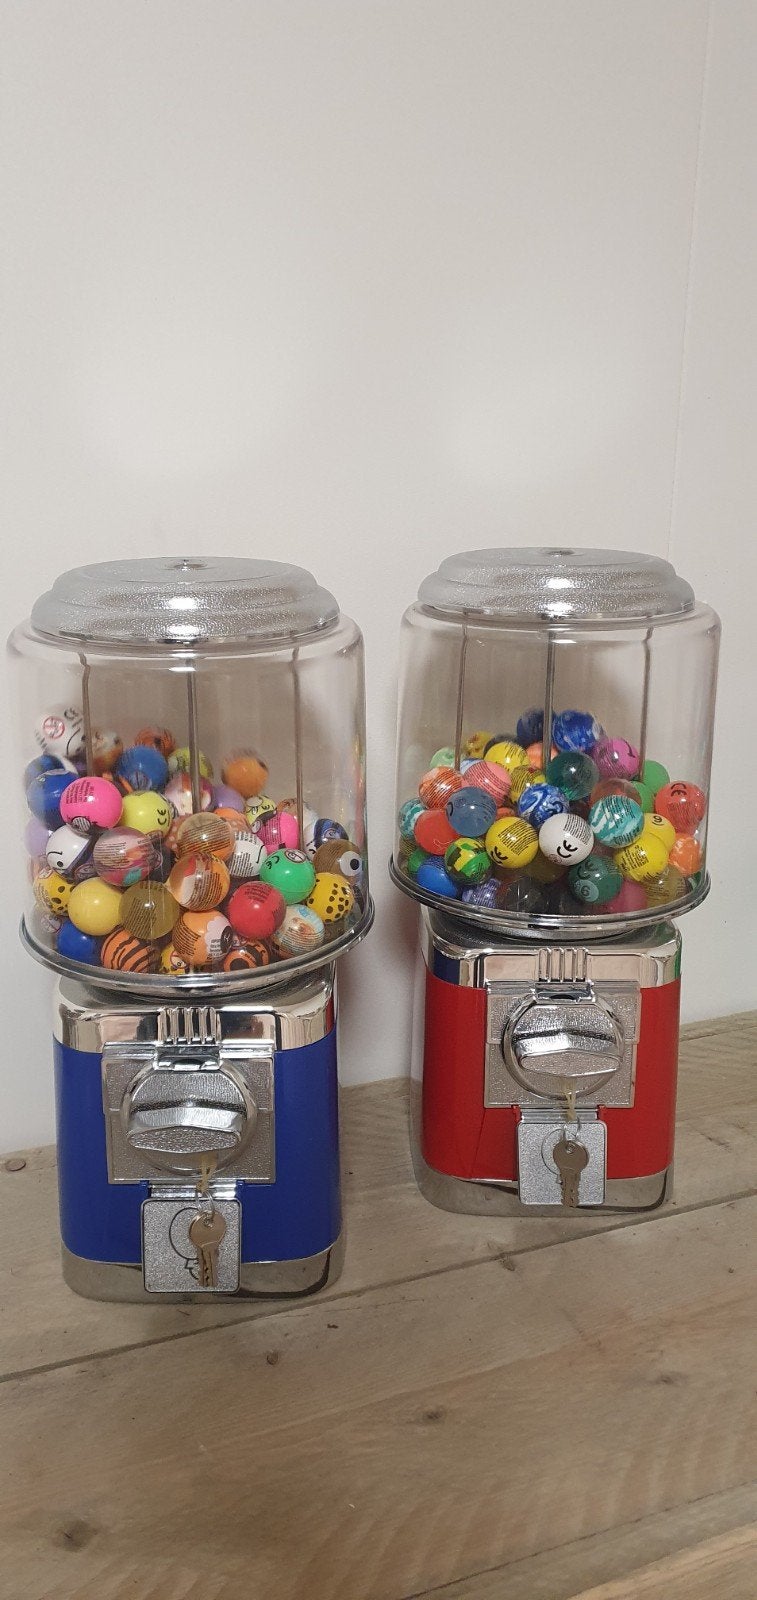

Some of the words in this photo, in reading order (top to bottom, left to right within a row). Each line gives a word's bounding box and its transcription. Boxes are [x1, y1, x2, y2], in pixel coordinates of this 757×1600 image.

[157, 809, 167, 825] CE
[491, 846, 508, 865] CE
[556, 839, 578, 859] CE
